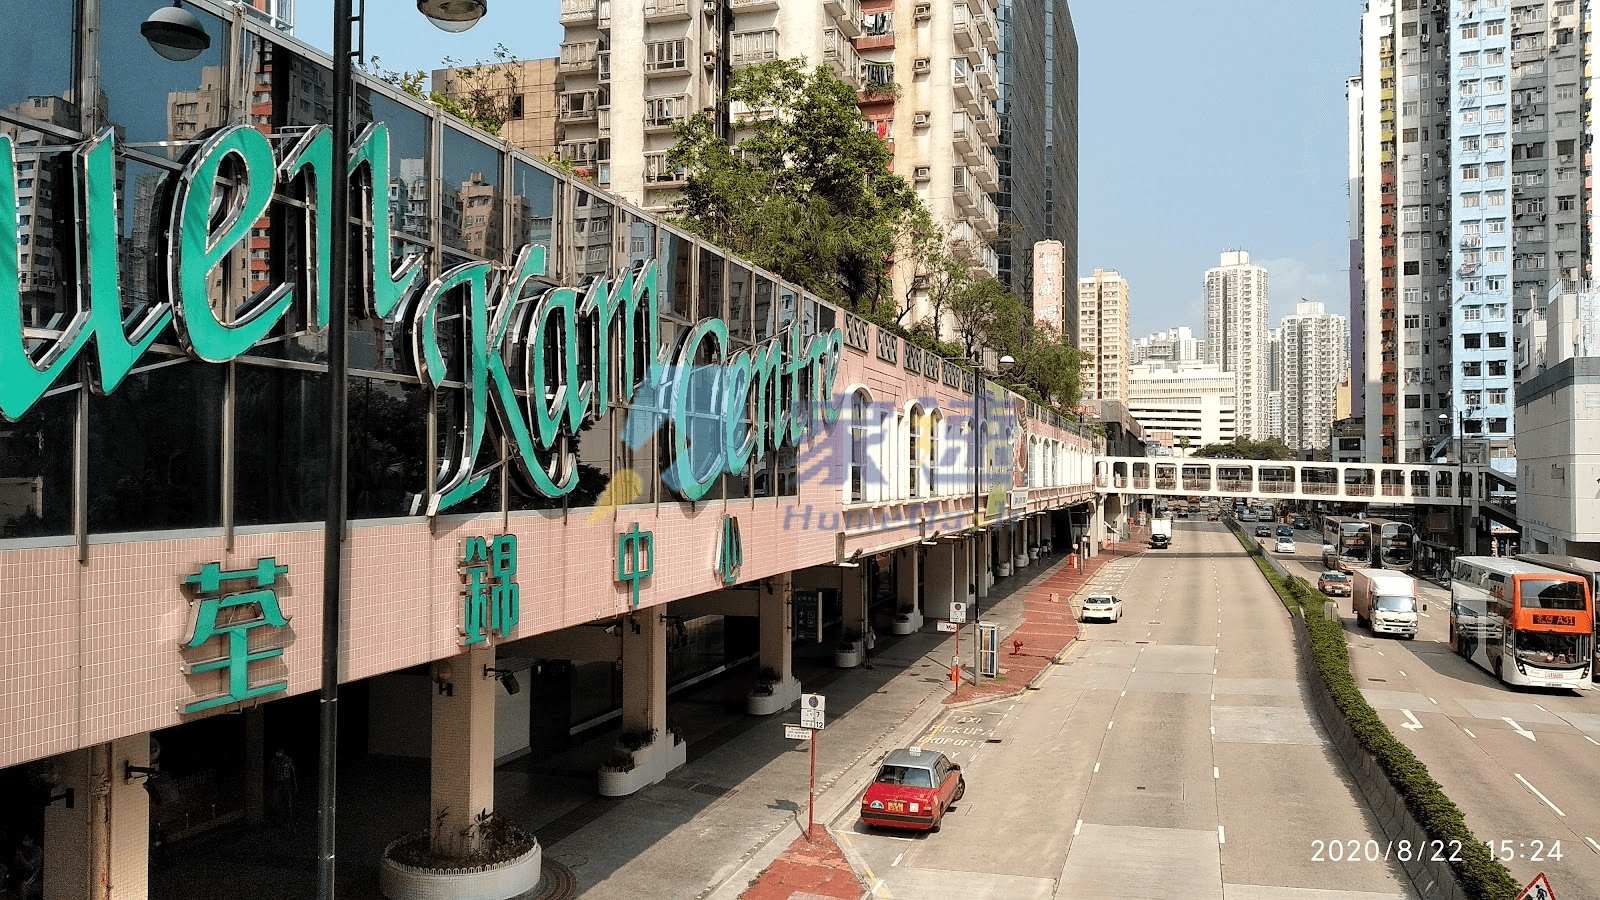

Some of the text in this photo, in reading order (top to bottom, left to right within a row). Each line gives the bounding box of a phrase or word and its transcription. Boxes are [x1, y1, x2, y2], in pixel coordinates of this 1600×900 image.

[410, 243, 668, 518] Kam
[670, 316, 844, 502] Centre
[952, 715, 983, 724] TAXI
[816, 721, 824, 729] 12
